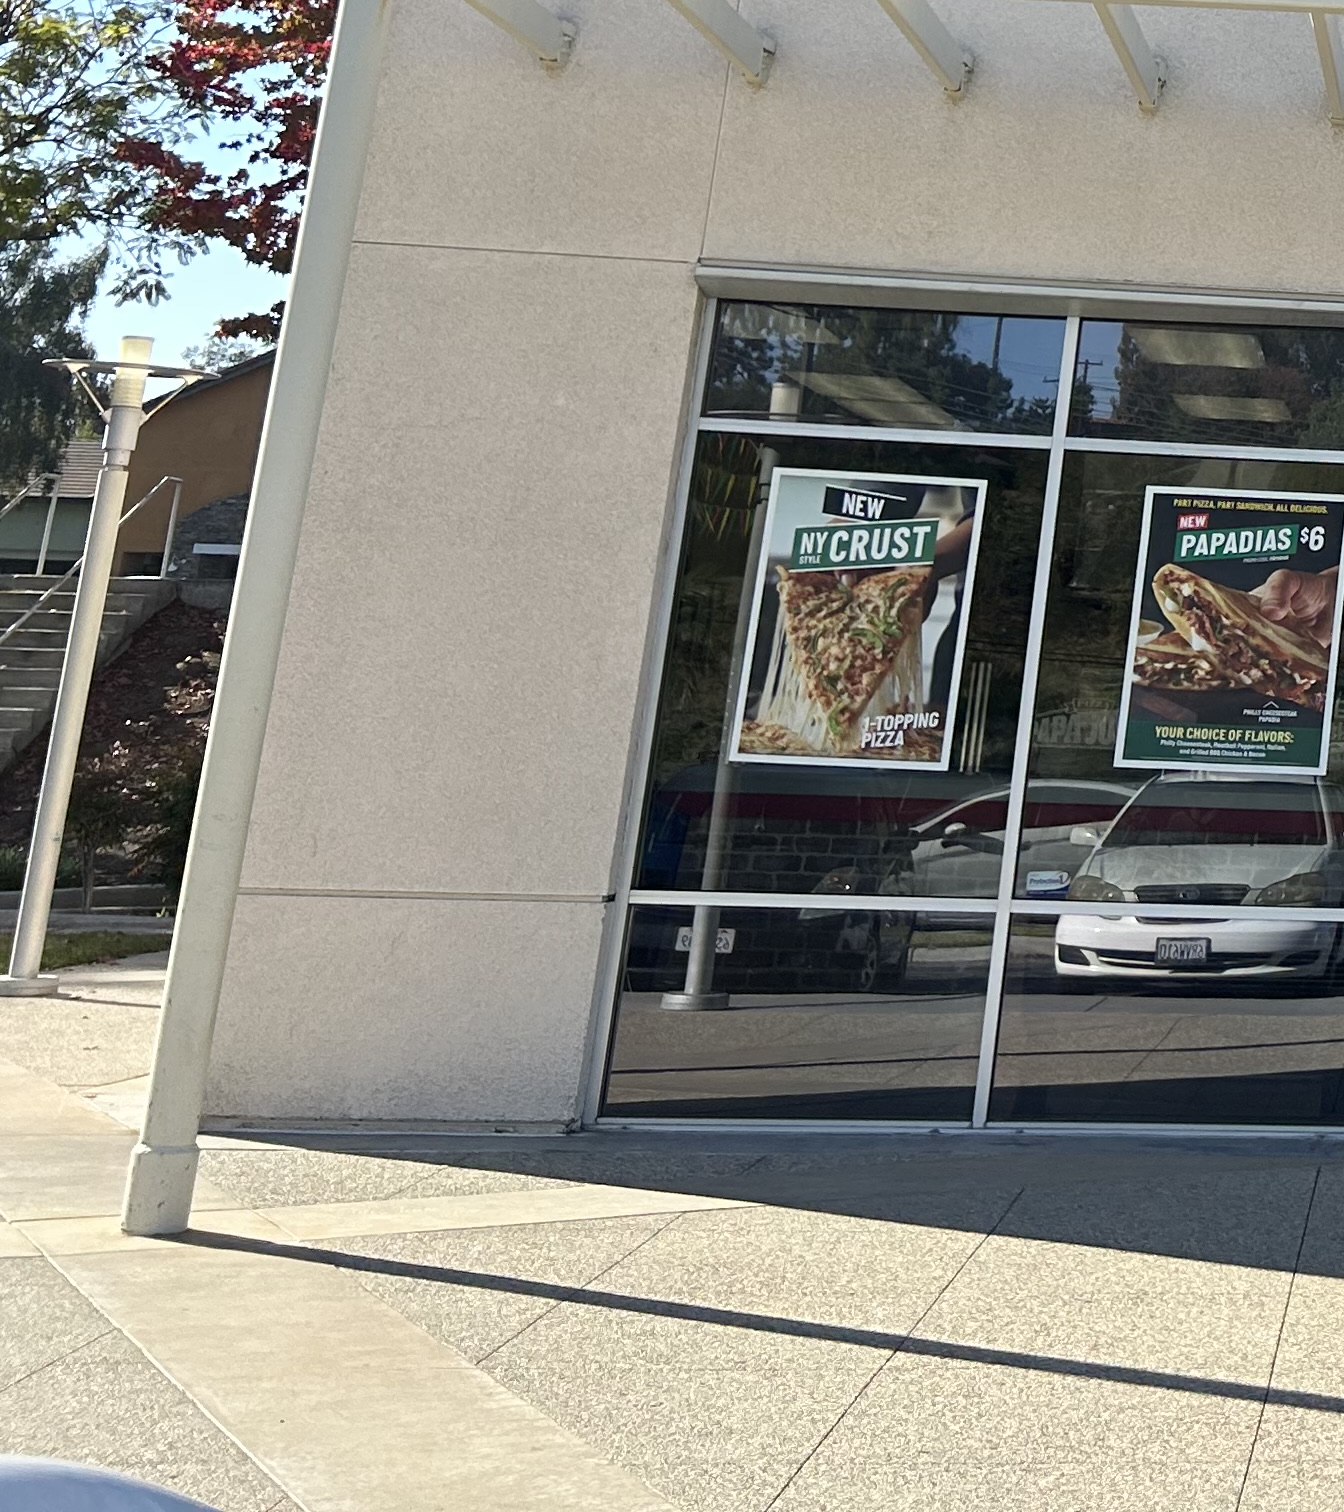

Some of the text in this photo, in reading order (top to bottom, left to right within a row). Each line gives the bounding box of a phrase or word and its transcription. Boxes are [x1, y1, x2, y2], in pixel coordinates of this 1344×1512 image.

[842, 492, 885, 520] NEW
[1179, 515, 1207, 528] NEW
[799, 525, 931, 563] NY CRUST
[1180, 526, 1325, 557] PAPADIAS $6
[799, 554, 822, 565] STYLE
[862, 711, 940, 732] 1-TOPPING
[861, 730, 904, 749] PIZZA
[1155, 726, 1294, 743] YOUR CHOICE OF FLAVORS:
